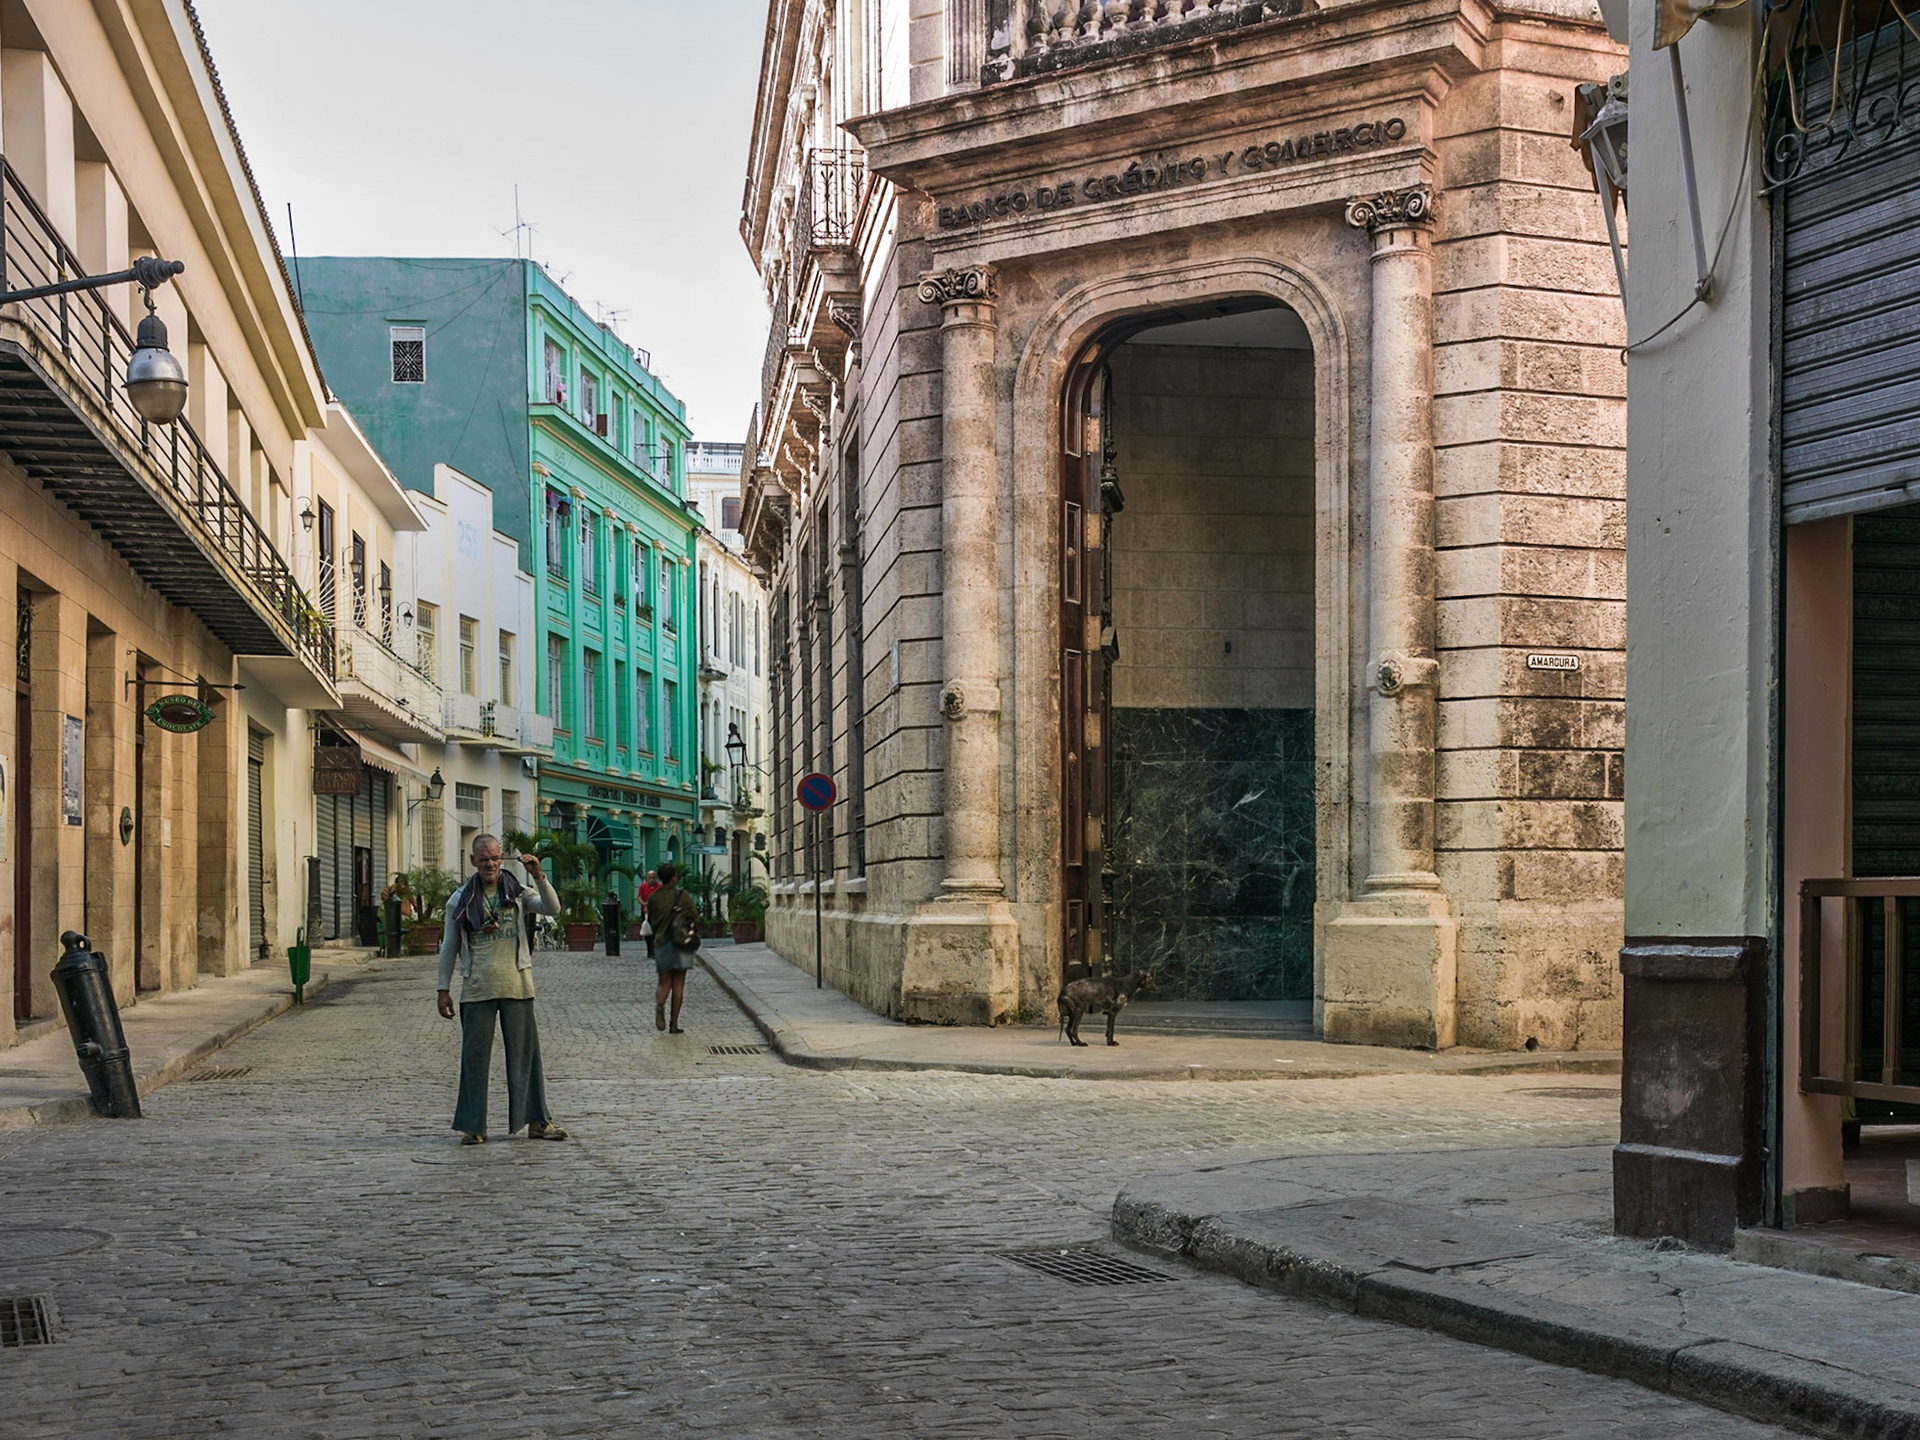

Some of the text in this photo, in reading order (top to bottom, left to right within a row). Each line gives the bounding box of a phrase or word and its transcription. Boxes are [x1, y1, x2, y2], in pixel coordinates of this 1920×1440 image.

[938, 117, 1406, 227] BANCO DE CRÉDITO Y COMERCIO
[1530, 656, 1576, 667] AMARGURA
[158, 696, 201, 709] MUSEO DEL
[157, 718, 201, 731] CHOCOLATE
